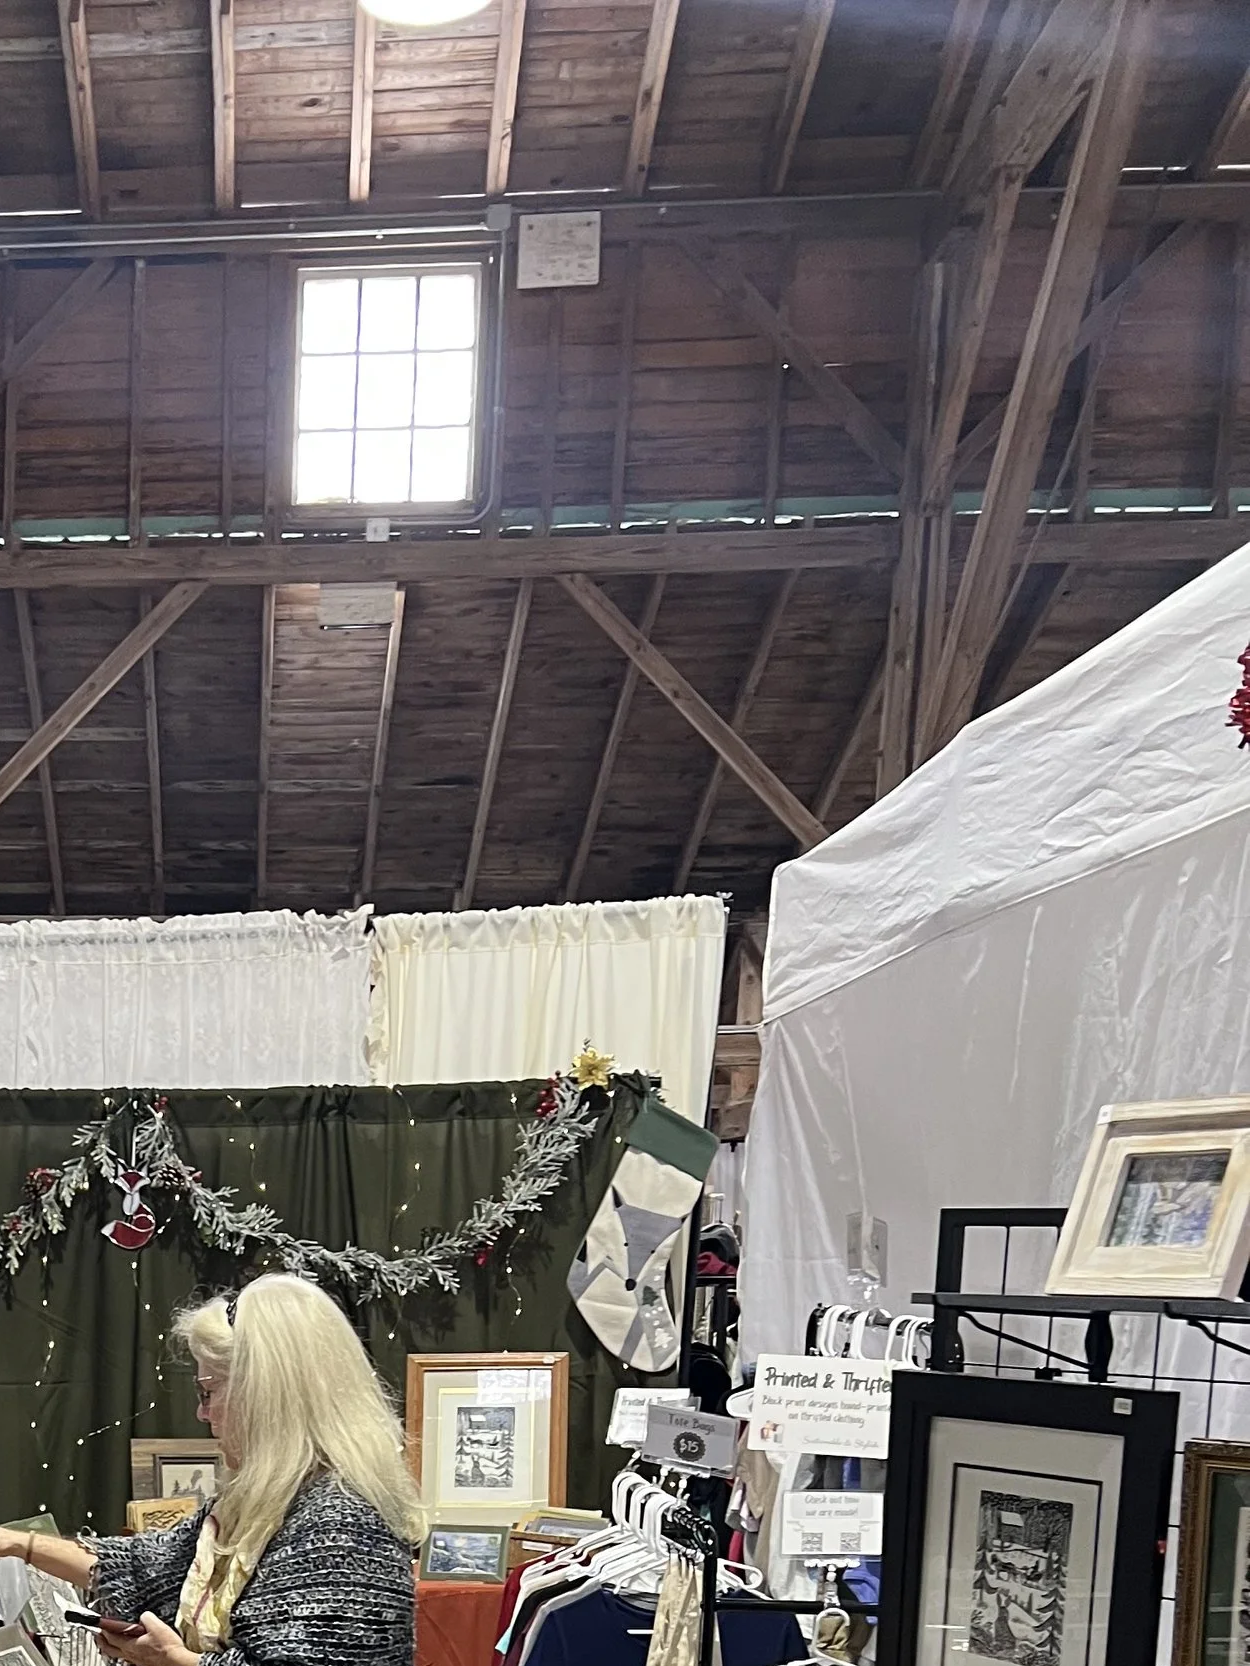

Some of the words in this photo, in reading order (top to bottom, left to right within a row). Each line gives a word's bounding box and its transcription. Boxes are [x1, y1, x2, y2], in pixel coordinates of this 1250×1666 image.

[764, 1366, 818, 1389] Printed
[823, 1373, 836, 1390] &
[841, 1371, 892, 1396] Thrifte
[668, 1413, 689, 1427] Tote
[692, 1420, 716, 1436] Bags
[834, 1416, 865, 1428] clothing
[679, 1438, 699, 1453] $15
